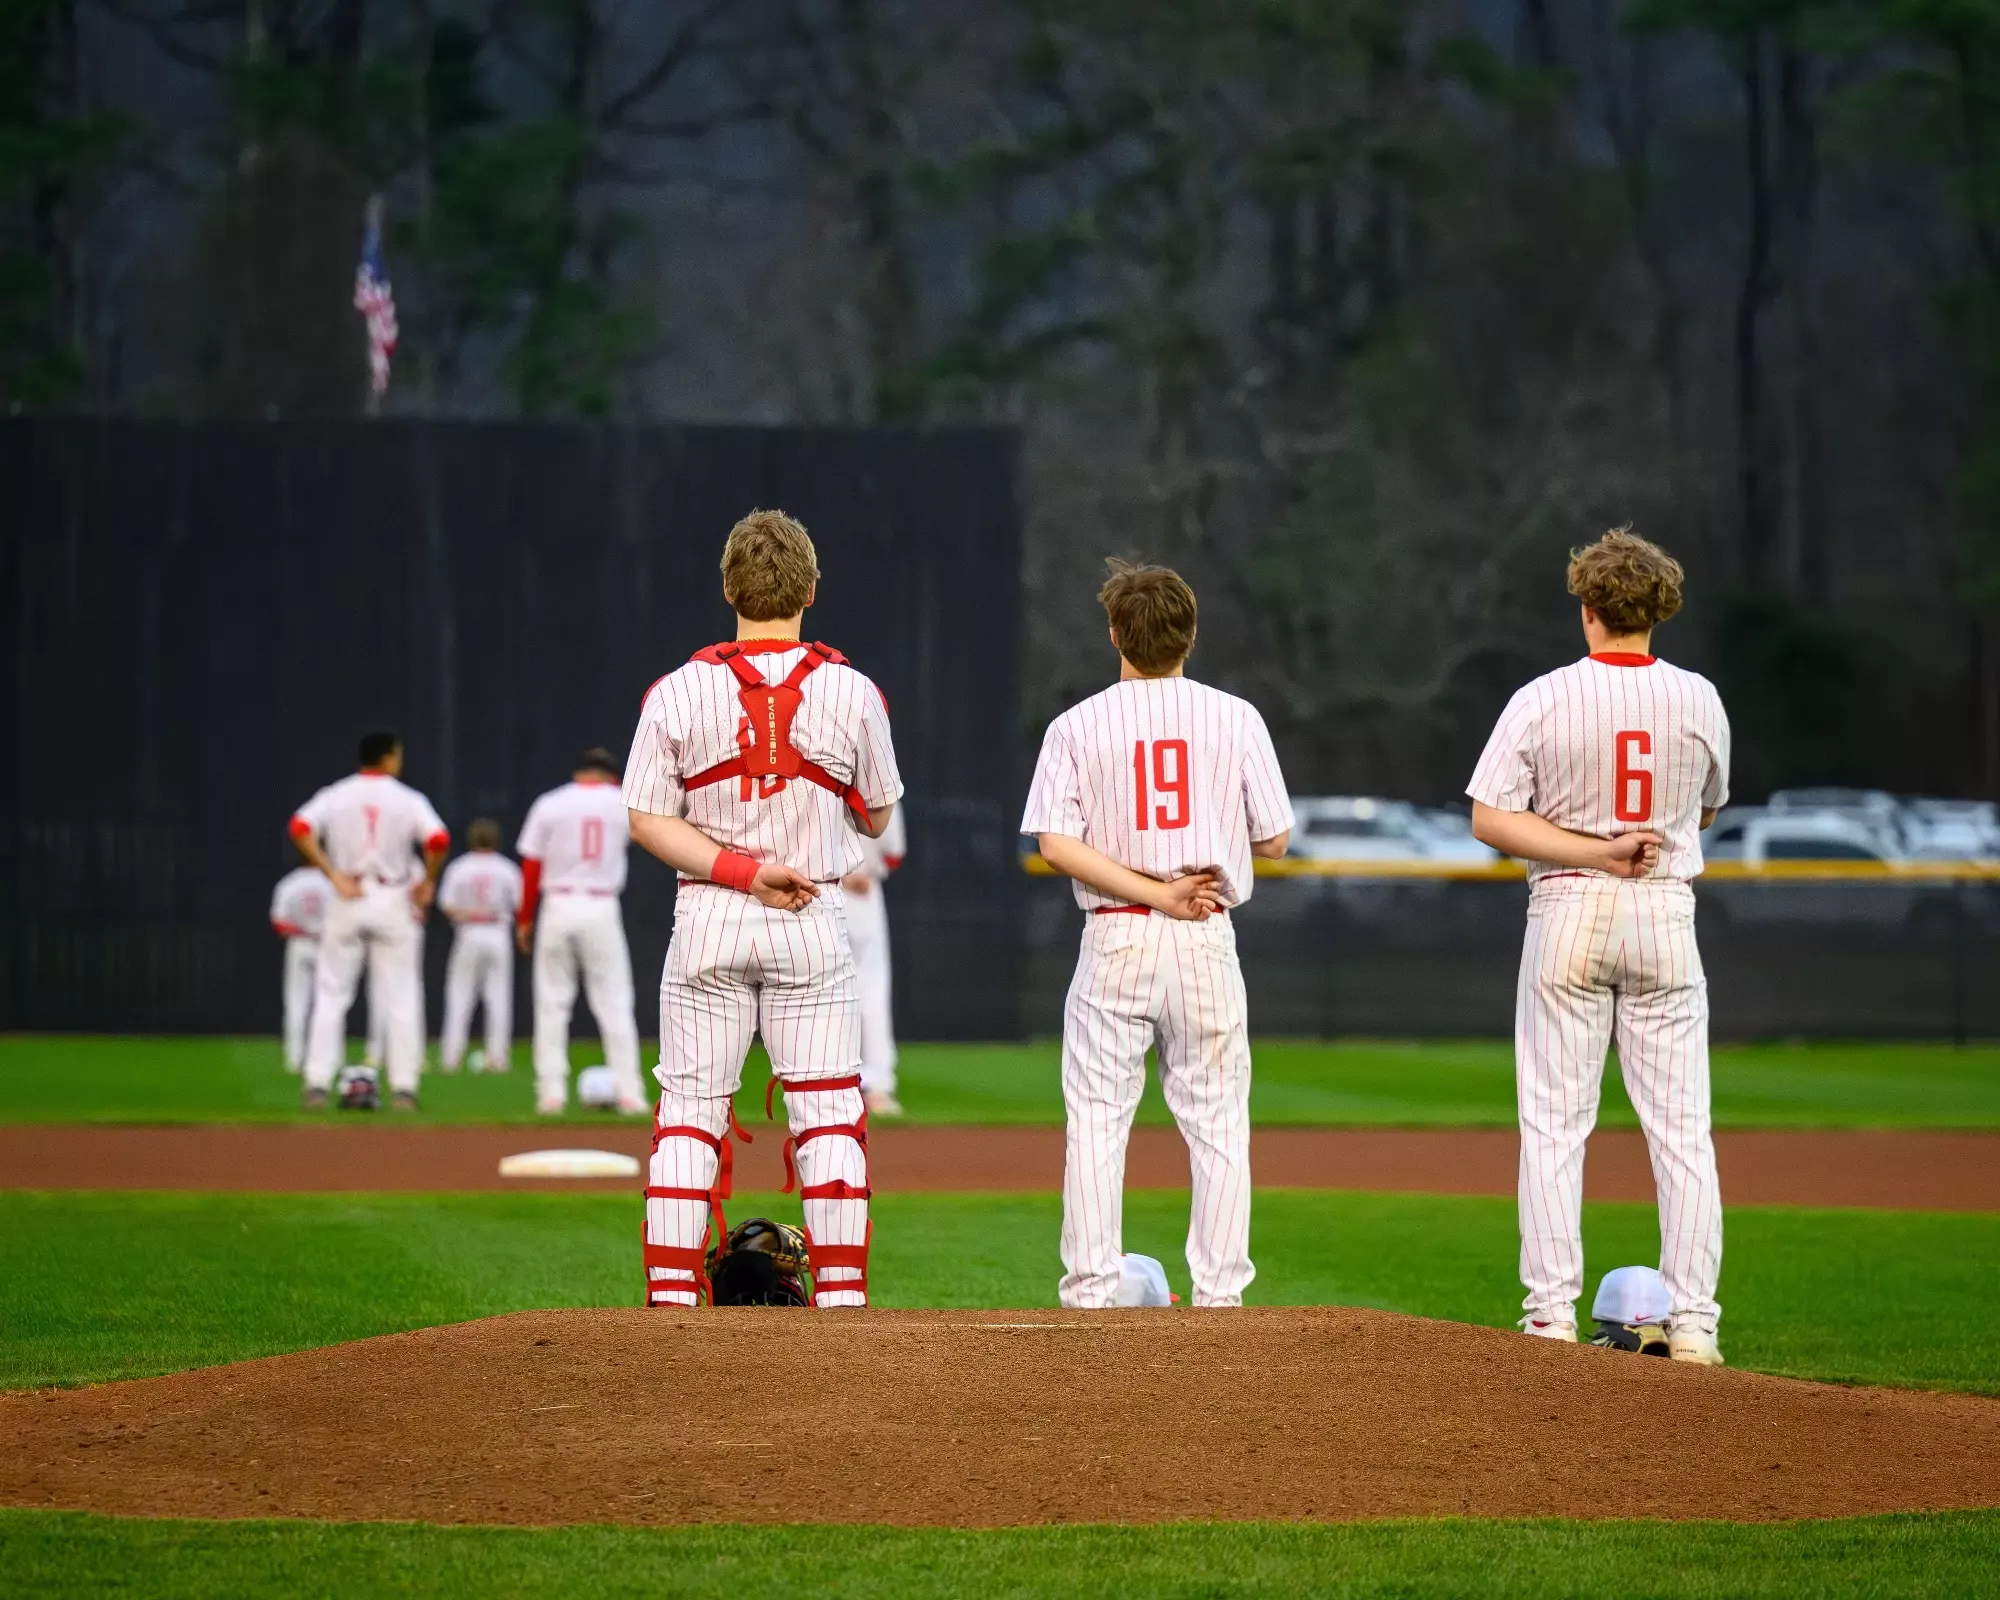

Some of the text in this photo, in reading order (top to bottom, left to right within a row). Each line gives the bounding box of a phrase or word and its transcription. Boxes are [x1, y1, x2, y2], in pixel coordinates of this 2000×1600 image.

[767, 696, 777, 765] EVOSHIELD
[1615, 730, 1652, 822] 6
[1133, 739, 1190, 831] 19
